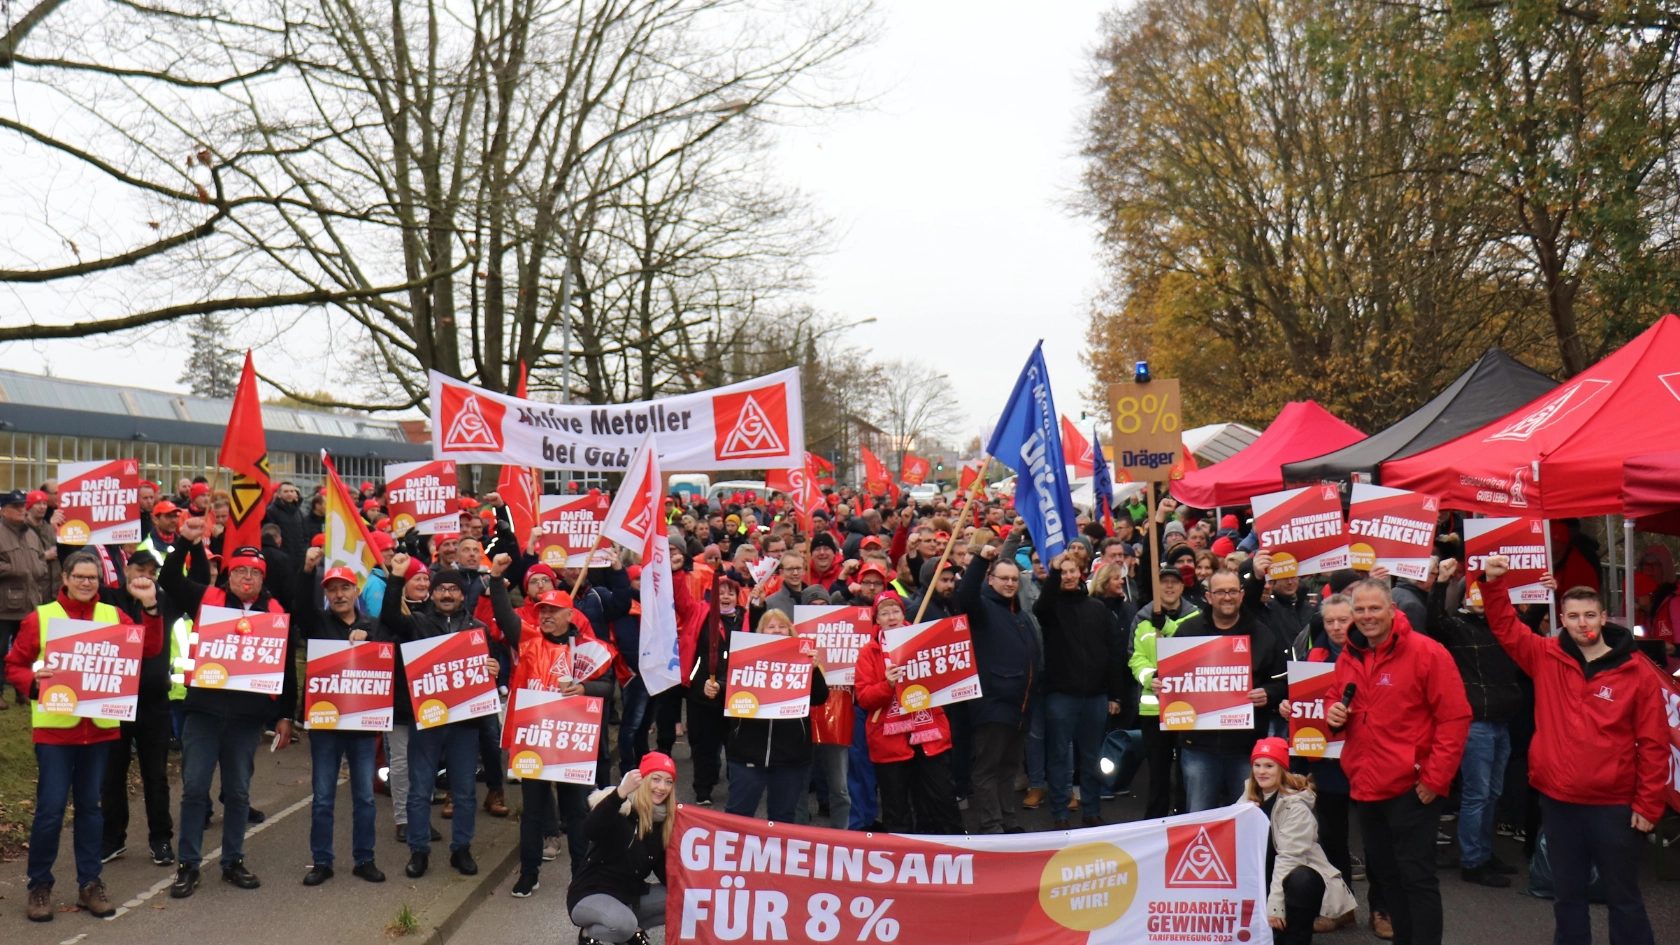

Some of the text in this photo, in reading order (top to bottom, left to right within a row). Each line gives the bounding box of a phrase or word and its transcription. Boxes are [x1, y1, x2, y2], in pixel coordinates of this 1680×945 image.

[517, 404, 691, 434] Aktive Metaller
[1116, 394, 1178, 434] 8%
[543, 436, 577, 464] bei
[1122, 450, 1174, 469] Dräger
[82, 476, 120, 491] DAFÜR
[406, 475, 440, 488] DAFÜR
[61, 488, 138, 508] STREITEN
[389, 486, 456, 504] STREITEN
[92, 505, 126, 522] WIR
[416, 500, 446, 515] WIR
[561, 508, 594, 520] DAFÜR
[1291, 511, 1340, 526] EINKOMMEN
[1383, 515, 1434, 531] EINKOMMEN
[1261, 520, 1342, 547] STÄRKEN!
[1348, 518, 1431, 546] STÄRKEN!
[1499, 545, 1545, 554] EINKOMMEN
[1351, 556, 1361, 564] ÜR
[1467, 551, 1546, 571] STKEN!
[817, 621, 854, 633] DAFÜR
[74, 641, 119, 657] DAFÜR
[199, 639, 238, 660] FÜR
[226, 634, 286, 647] ES IST ZEIT
[798, 633, 871, 648] REITEN
[827, 648, 859, 663] WIR
[917, 640, 970, 661] ES IST ZEIT
[46, 652, 139, 676] STREITEN
[433, 654, 488, 675] ES IST ZEIT
[756, 660, 811, 673] ES IST ZEIT
[897, 659, 932, 683] FÜR
[1195, 665, 1249, 675] EINKOMMEN
[82, 672, 122, 693] WIR
[342, 669, 392, 679] EINKOMMEN
[730, 666, 767, 688] FÜR
[1161, 672, 1249, 693] STÄRKEN!
[308, 674, 391, 695] STÄRKEN!
[413, 673, 449, 697] FÜR
[311, 715, 324, 724] FÜR
[541, 719, 599, 734] ES IST ZEIT
[1166, 716, 1180, 725] FÜR
[515, 724, 552, 747] FÜR
[1296, 741, 1309, 750] FÜR
[680, 827, 974, 885] GEMEINSAM
[1061, 858, 1117, 882] DAFÜR
[1050, 872, 1128, 898] STREITEN
[680, 875, 788, 941] FÜR
[1070, 891, 1109, 911] WIR!
[1148, 899, 1237, 914] SOLIDARITÄT
[1148, 934, 1211, 942] TARIFBEWEGUNG
